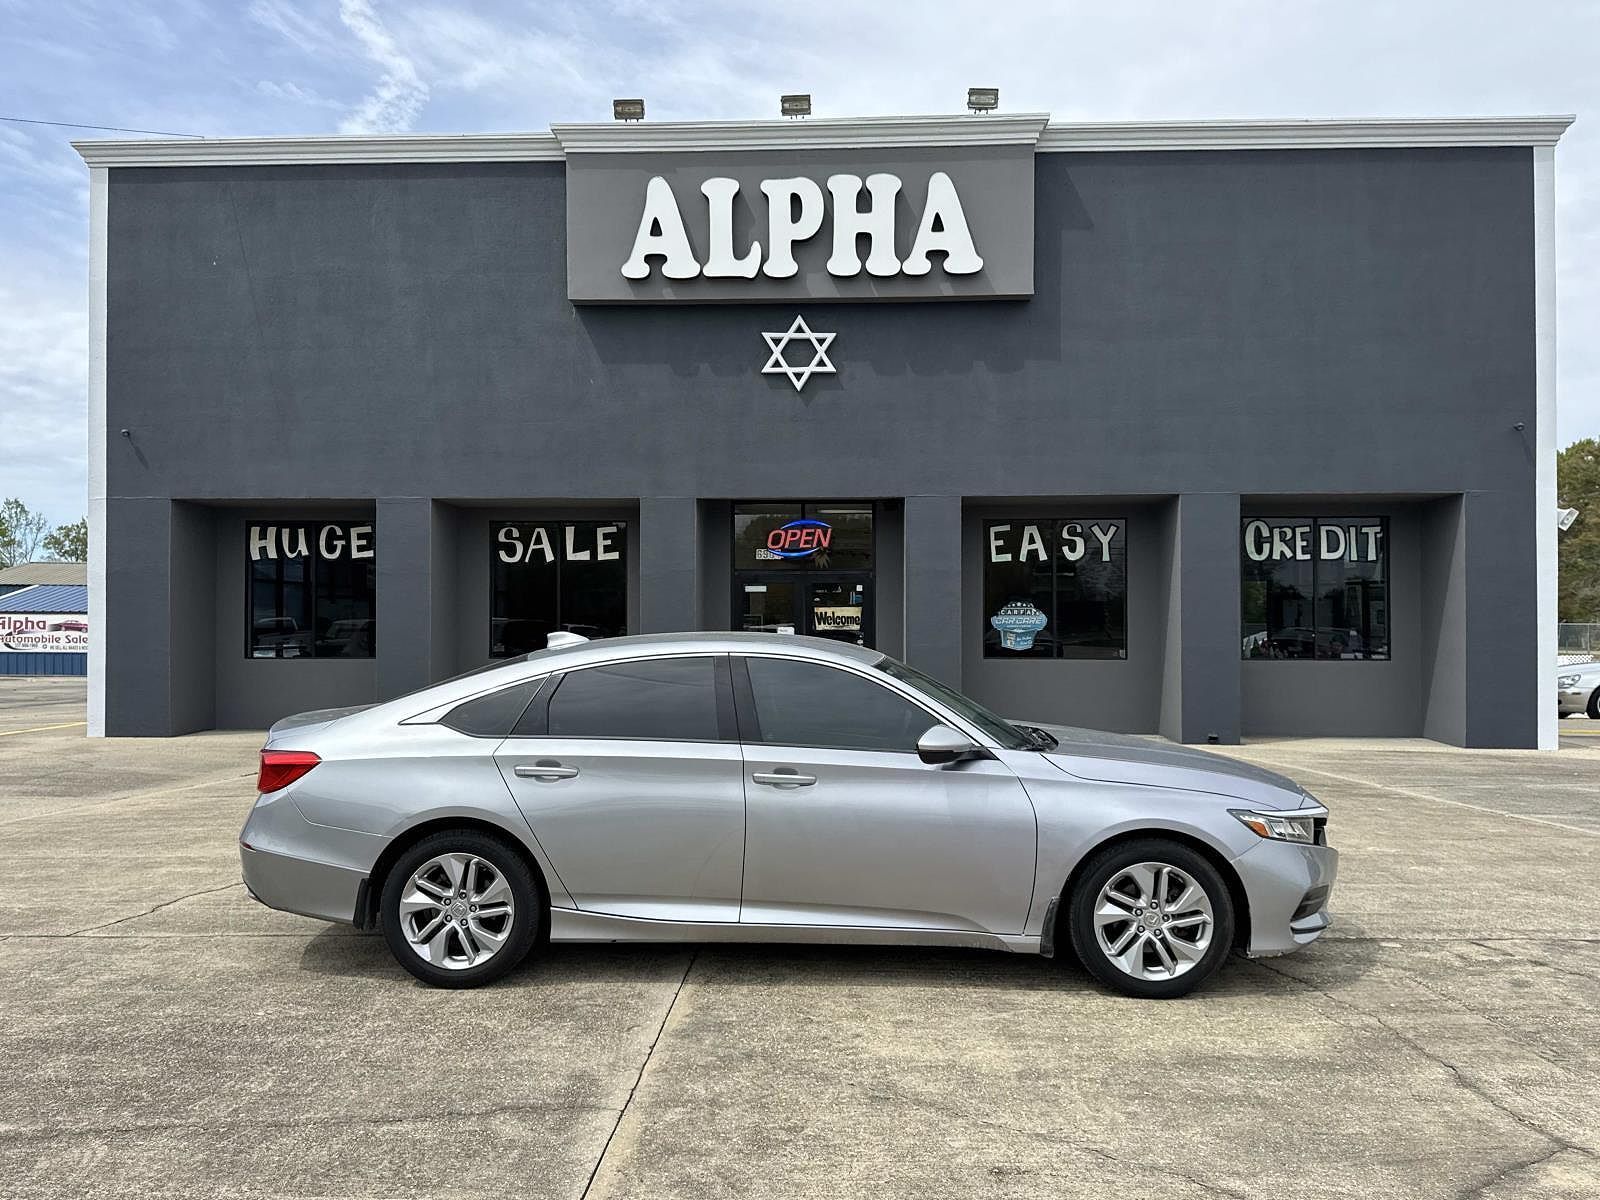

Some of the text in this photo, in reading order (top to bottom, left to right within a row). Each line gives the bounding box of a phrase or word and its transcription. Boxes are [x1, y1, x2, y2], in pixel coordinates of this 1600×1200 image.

[621, 172, 984, 279] ALPHA
[250, 525, 374, 560] HUGE
[498, 526, 620, 563] SALE
[767, 528, 832, 549] OPEN
[990, 523, 1118, 562] EASY
[1245, 520, 1381, 561] CREDIT
[815, 611, 861, 626] Welcome
